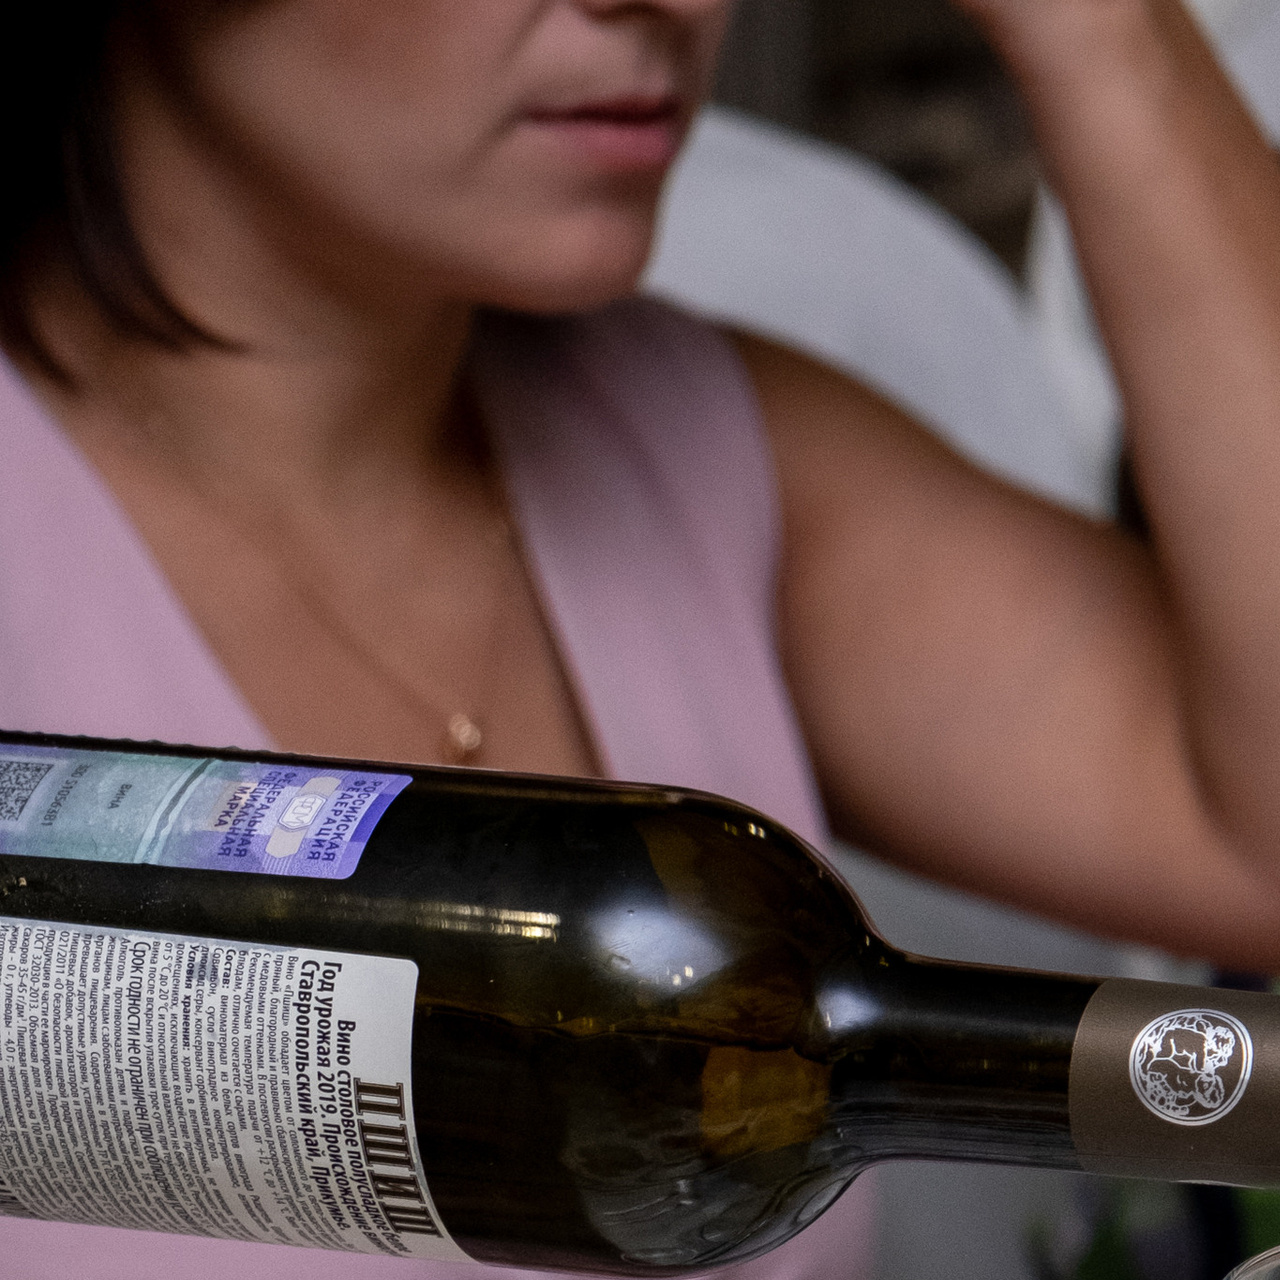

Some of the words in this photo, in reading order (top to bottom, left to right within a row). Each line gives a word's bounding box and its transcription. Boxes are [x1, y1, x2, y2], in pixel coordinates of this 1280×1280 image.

[107, 783, 133, 809] ВИНА
[214, 785, 251, 828] МАРКА
[218, 771, 280, 857] СПЕЦИАЛЬНАЯ
[233, 773, 296, 859] ФЕДЕРАЛЬНАЯ
[307, 779, 366, 861] ФЕДЕРАЦИЯ
[322, 780, 383, 862] РОССИЙСКАЯ
[6, 925, 19, 953] жиры
[17, 926, 31, 964] сахаров
[33, 928, 45, 950] ГОСТ
[41, 929, 55, 980] продукция
[54, 930, 69, 974] 021/2011
[67, 931, 79, 976] пищевых
[78, 932, 91, 987] превышает
[92, 934, 104, 973] органов
[115, 936, 130, 982] Алкоголь
[127, 941, 151, 973] Срок
[149, 940, 159, 964] вина
[163, 941, 172, 953] от
[6, 963, 16, 971] 0
[29, 953, 41, 1011] 32030-2013.
[53, 977, 63, 989] «О
[101, 935, 116, 990] женщинам,
[146, 966, 156, 995] после
[158, 973, 168, 986] до
[169, 943, 184, 1009] помещениях,
[184, 944, 198, 989] Условия
[195, 945, 209, 987] диоксид
[206, 947, 223, 997] Совиньон,
[222, 948, 235, 988] Состав:
[232, 950, 248, 991] блюдам,
[269, 953, 283, 994] пряный,
[285, 955, 297, 980] Вино
[317, 961, 342, 993] Год
[2, 982, 12, 1028] углеводы
[63, 978, 75, 1021] добавок,
[100, 993, 110, 1024] лицам
[125, 975, 142, 1035] годности
[158, 987, 168, 1000] 20
[193, 988, 204, 1015] серы,
[242, 951, 260, 1029] Рекомендуемая
[257, 959, 269, 1014] медовыми
[282, 984, 293, 1026] «Пшиш»
[41, 1017, 48, 1028] ее
[53, 992, 63, 1055] безопасности
[74, 989, 85, 1048] допустимые
[87, 977, 98, 1045] пищеварения.
[112, 986, 122, 1063] противопоказан
[143, 996, 153, 1043] вскрытия
[180, 994, 191, 1050] хранения:
[205, 1005, 215, 1033] сусло
[217, 994, 228, 1065] виноматериал
[231, 994, 240, 1034] отлично
[266, 997, 280, 1063] благородный
[313, 995, 332, 1067] урожая
[4, 1037, 15, 1052] 4,0
[15, 1025, 26, 1067] Пищевая
[29, 1015, 39, 1062] Объемная
[127, 1037, 141, 1054] не
[157, 1021, 170, 1091] относительной
[169, 1012, 179, 1082] исключающих
[192, 1017, 203, 1072] консервант
[256, 1016, 264, 1071] оттенками.
[279, 1030, 291, 1075] обладает
[291, 958, 320, 1114] Ставропольский
[336, 1019, 355, 1066] Вино
[30, 1065, 41, 1087] доля
[53, 1057, 69, 1098] пищевой
[62, 1024, 78, 1097] ароматизаторов
[75, 1049, 88, 1084] уровни,
[89, 1051, 104, 1105] Содержание
[102, 1031, 115, 1102] заболеваниями
[114, 1067, 126, 1095] детям
[143, 1044, 156, 1088] упаковки
[180, 1055, 193, 1093] хранить
[205, 1040, 218, 1101] виноградное
[220, 1070, 228, 1082] из
[231, 1036, 240, 1086] сочетается
[241, 1034, 253, 1095] температура
[6, 1064, 27, 1128] энергетическая
[18, 1068, 33, 1108] ценность
[125, 1055, 149, 1120] ограничен
[147, 1090, 159, 1110] трое
[194, 1074, 210, 1126] сорбиновая
[222, 1087, 232, 1116] белых
[267, 1073, 282, 1123] правильно
[280, 1078, 293, 1113] цветом
[317, 1070, 338, 1118] 2019.
[337, 1069, 358, 1147] столовое
[27, 1109, 36, 1119] на
[30, 1121, 42, 1135] 100
[35, 1090, 51, 1131] этилового
[45, 1093, 64, 1138] Продукция
[150, 1111, 164, 1134] суток
[161, 1093, 177, 1138] влажности
[173, 1084, 189, 1139] воздействие
[233, 1095, 246, 1131] сырами.
[246, 1099, 259, 1131] подачи
[257, 1082, 272, 1138] послевкусии
[286, 1116, 295, 1126] от
[121, 1109, 140, 1157] подросткам
[134, 1122, 155, 1144] при
[156, 1134, 168, 1150] при
[170, 1139, 180, 1150] не
[203, 1127, 218, 1161] кислота.
[225, 1120, 239, 1149] сортов
[253, 1134, 262, 1144] от
[288, 1129, 308, 1181] соломенного
[297, 1117, 327, 1162] край,
[256, 1147, 269, 1165] +12
[319, 1123, 372, 1230] Происхождение
[353, 1077, 444, 1238] ПШИШ
[263, 1178, 275, 1188] до
[301, 1182, 313, 1192] до
[308, 1165, 351, 1230] Прикумье.
[346, 1150, 390, 1231] полусладкое
